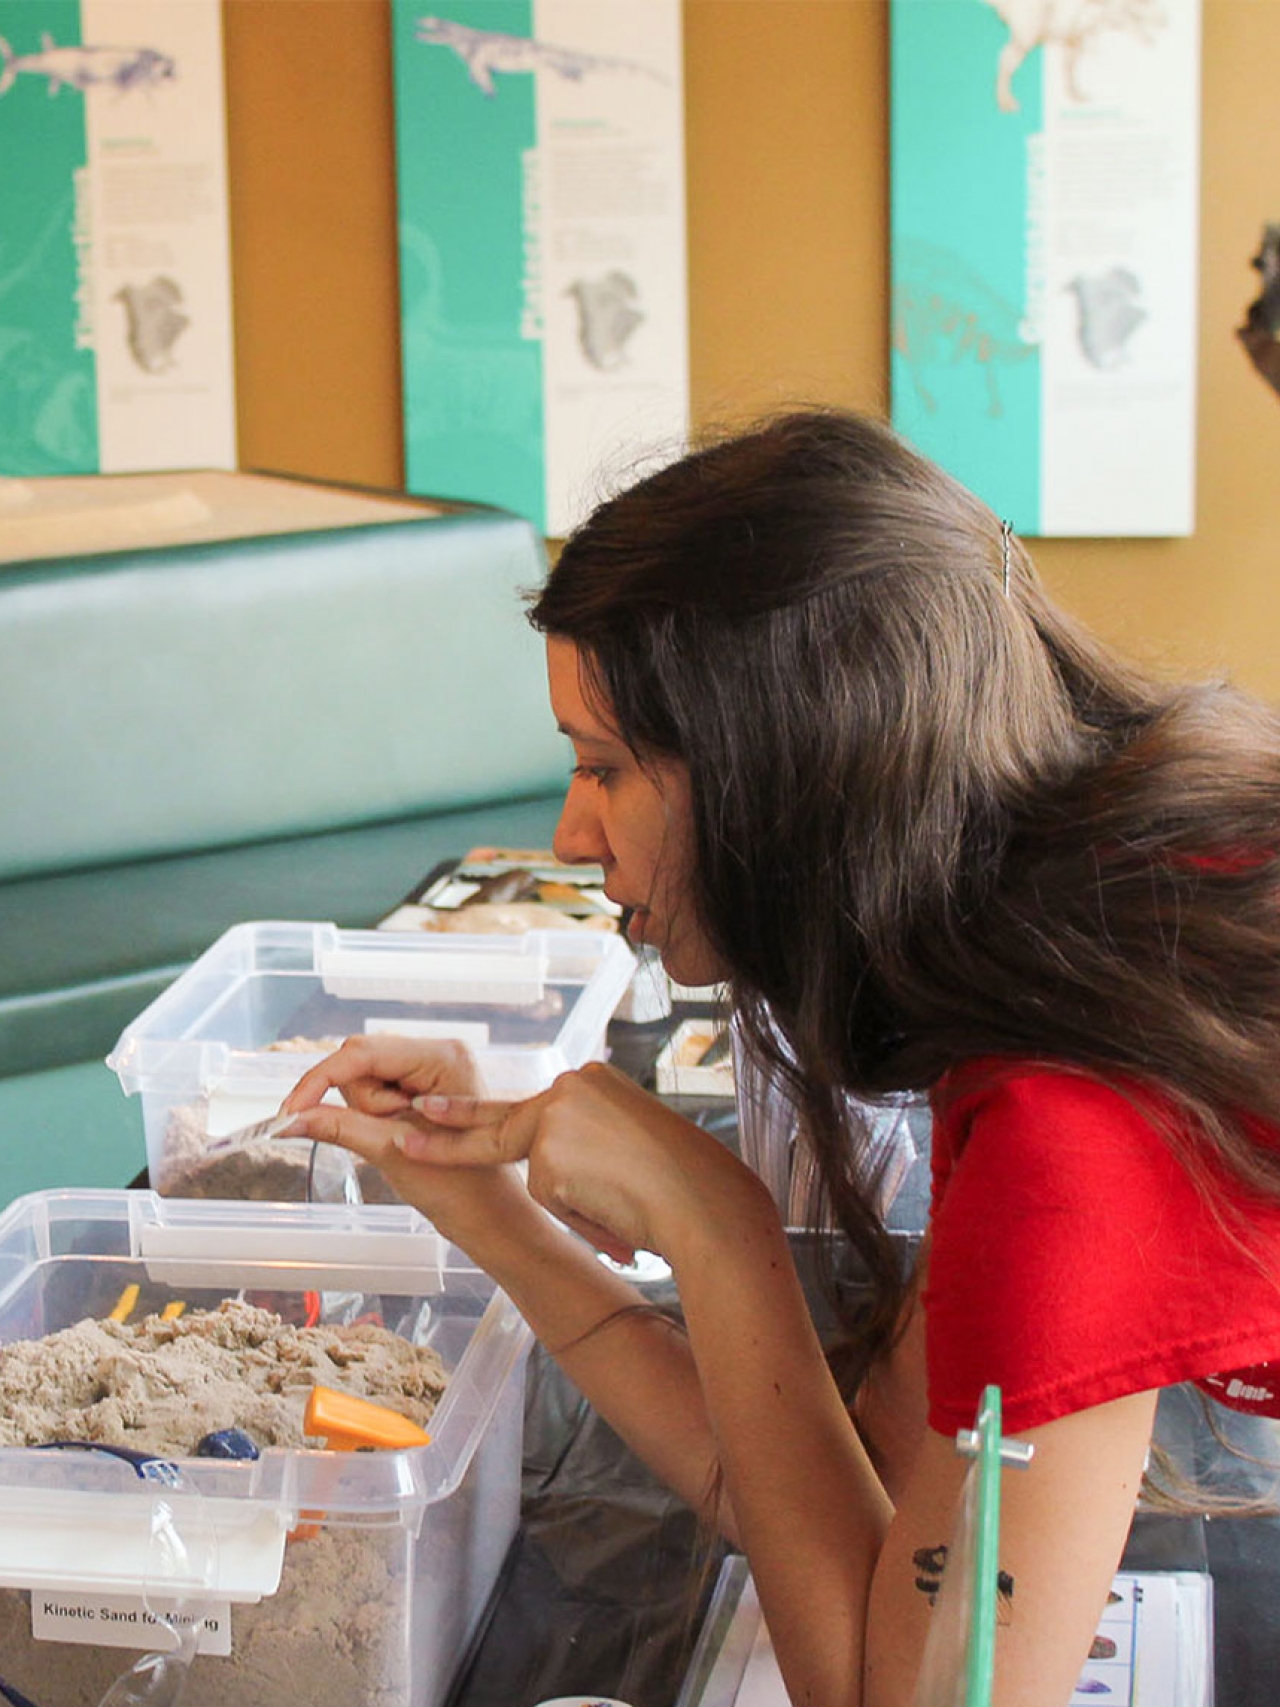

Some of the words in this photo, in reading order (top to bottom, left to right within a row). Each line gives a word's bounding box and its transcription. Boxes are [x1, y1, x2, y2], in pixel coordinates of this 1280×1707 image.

[43, 1602, 95, 1620] Kinetic
[99, 1607, 138, 1623] Sand
[142, 1611, 161, 1625] fo
